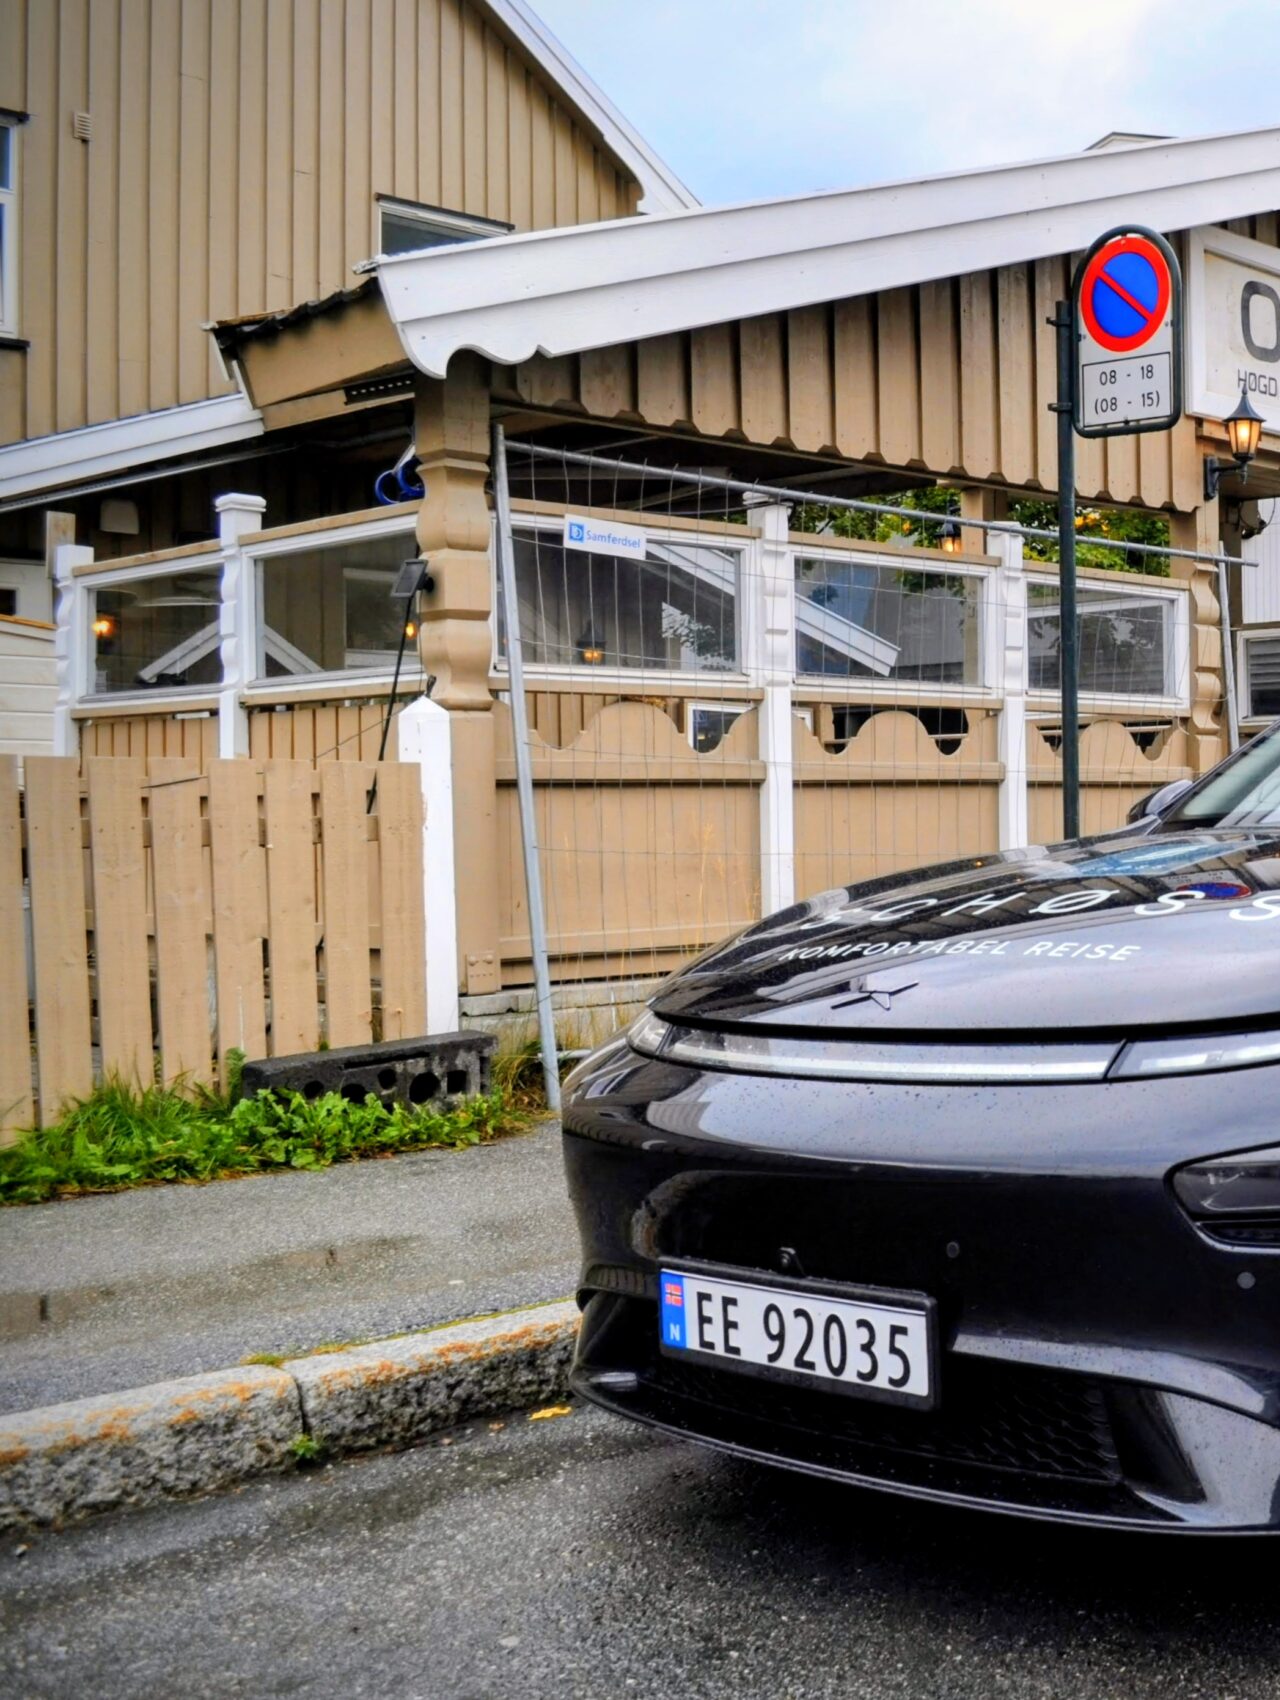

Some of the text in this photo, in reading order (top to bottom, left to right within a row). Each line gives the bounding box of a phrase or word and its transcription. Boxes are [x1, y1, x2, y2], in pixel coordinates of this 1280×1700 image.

[1099, 369, 1117, 386] 08
[1141, 364, 1154, 380] 18
[1094, 396, 1118, 415] (08
[1141, 390, 1160, 408] 15)
[586, 530, 641, 548] Samferdsel
[777, 940, 1143, 962] KOMFORTABEL REISE
[669, 1322, 681, 1342] N
[696, 1291, 911, 1388] EE 92035
